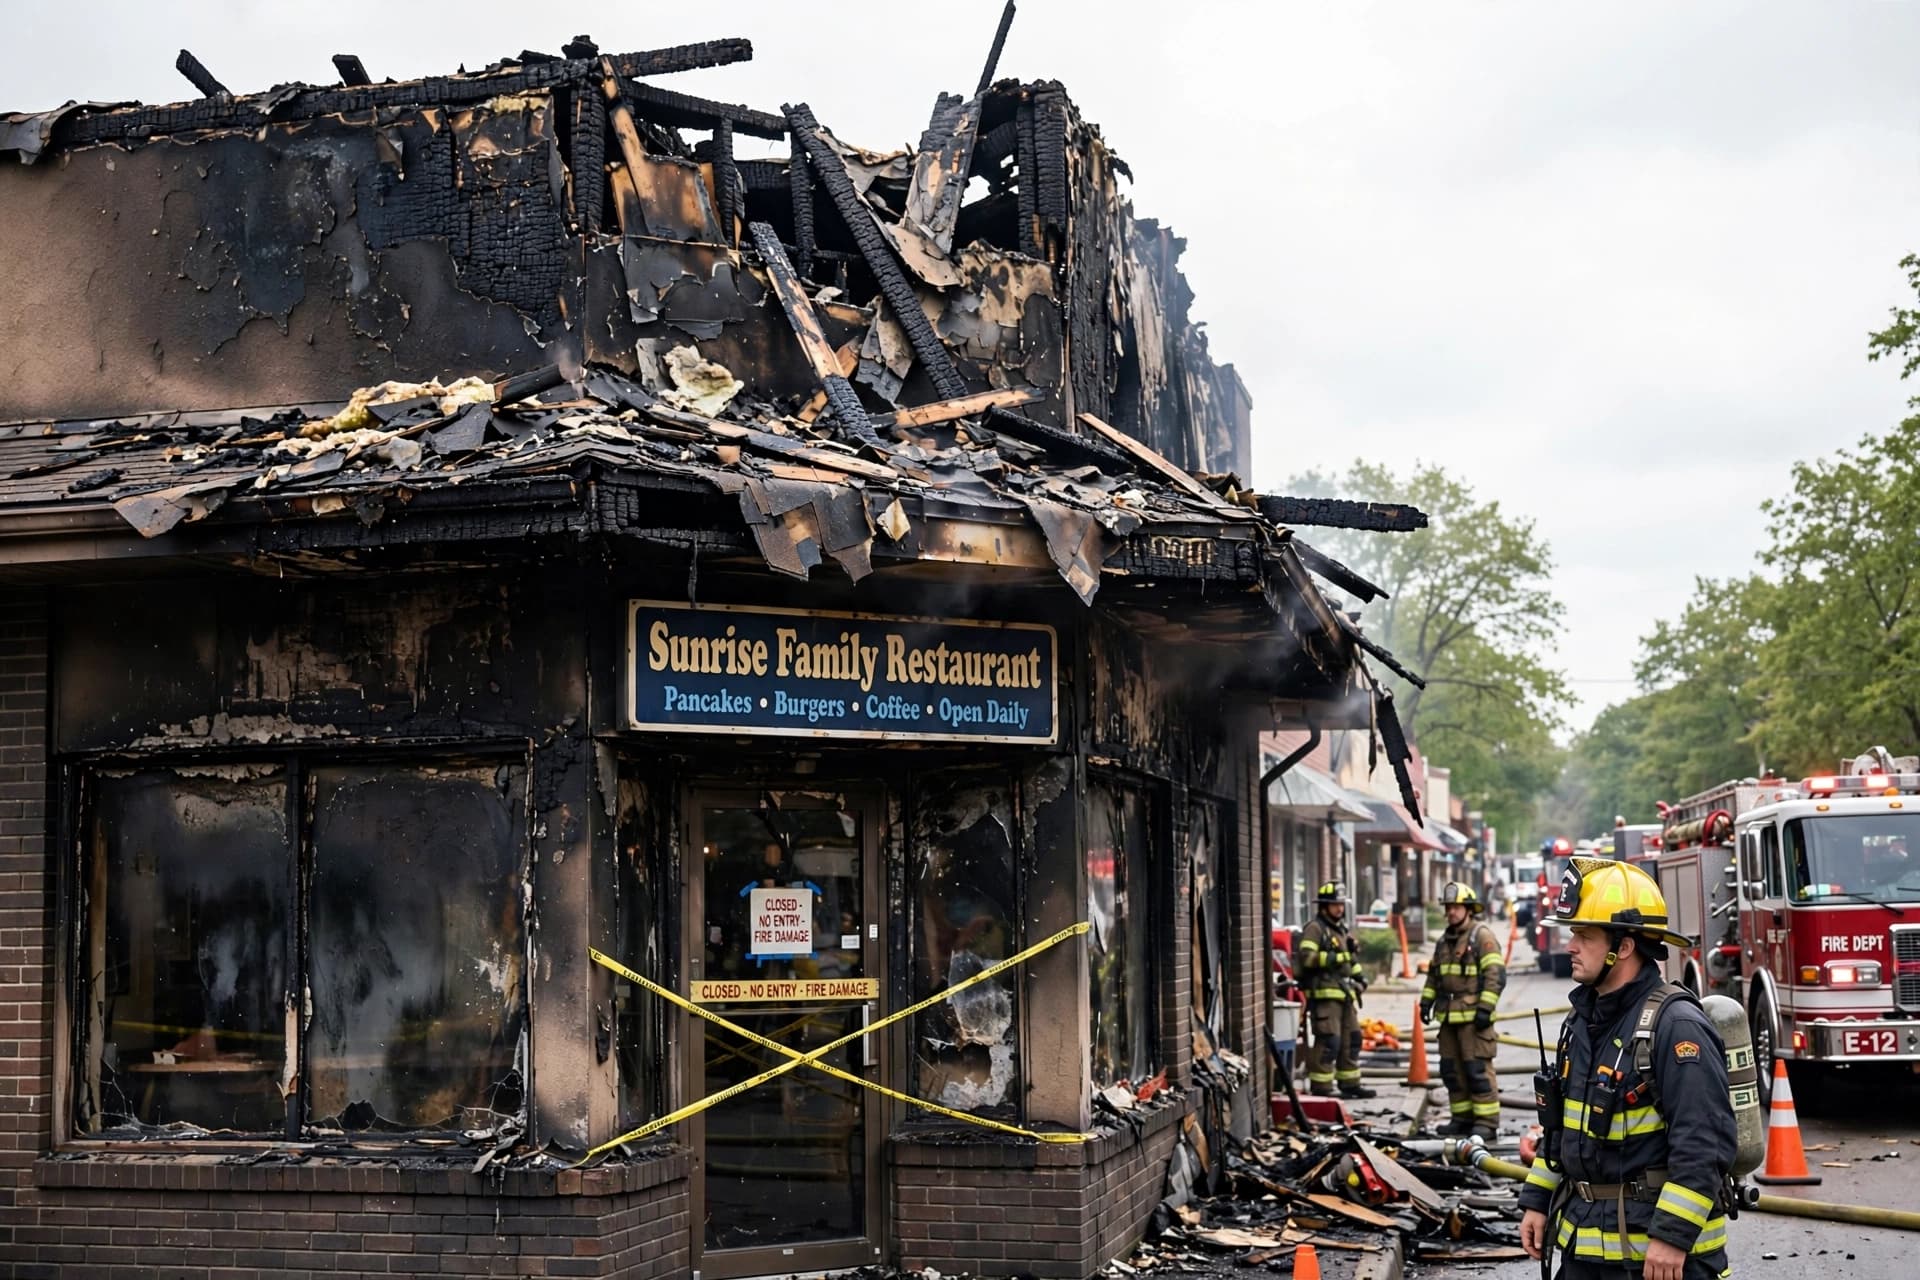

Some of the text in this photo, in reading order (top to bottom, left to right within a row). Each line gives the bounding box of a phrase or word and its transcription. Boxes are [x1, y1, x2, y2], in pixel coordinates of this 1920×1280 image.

[648, 620, 1041, 692] Sunrise Family Restaurant
[663, 685, 1029, 730] Pancakes Burgers Coffee Open Daily
[765, 898, 798, 911] CLOSED
[759, 914, 771, 928] NO
[773, 914, 801, 928] ENTRY
[754, 930, 809, 943] FIRE DAMAGE
[1821, 934, 1885, 952] FIRE DEPT
[702, 984, 741, 999] CLOSED
[750, 984, 764, 998] NO
[767, 983, 797, 998] ENTRY
[805, 983, 827, 997] FIRE
[829, 982, 869, 997] DAMAGE
[1845, 1031, 1897, 1053] E-12
